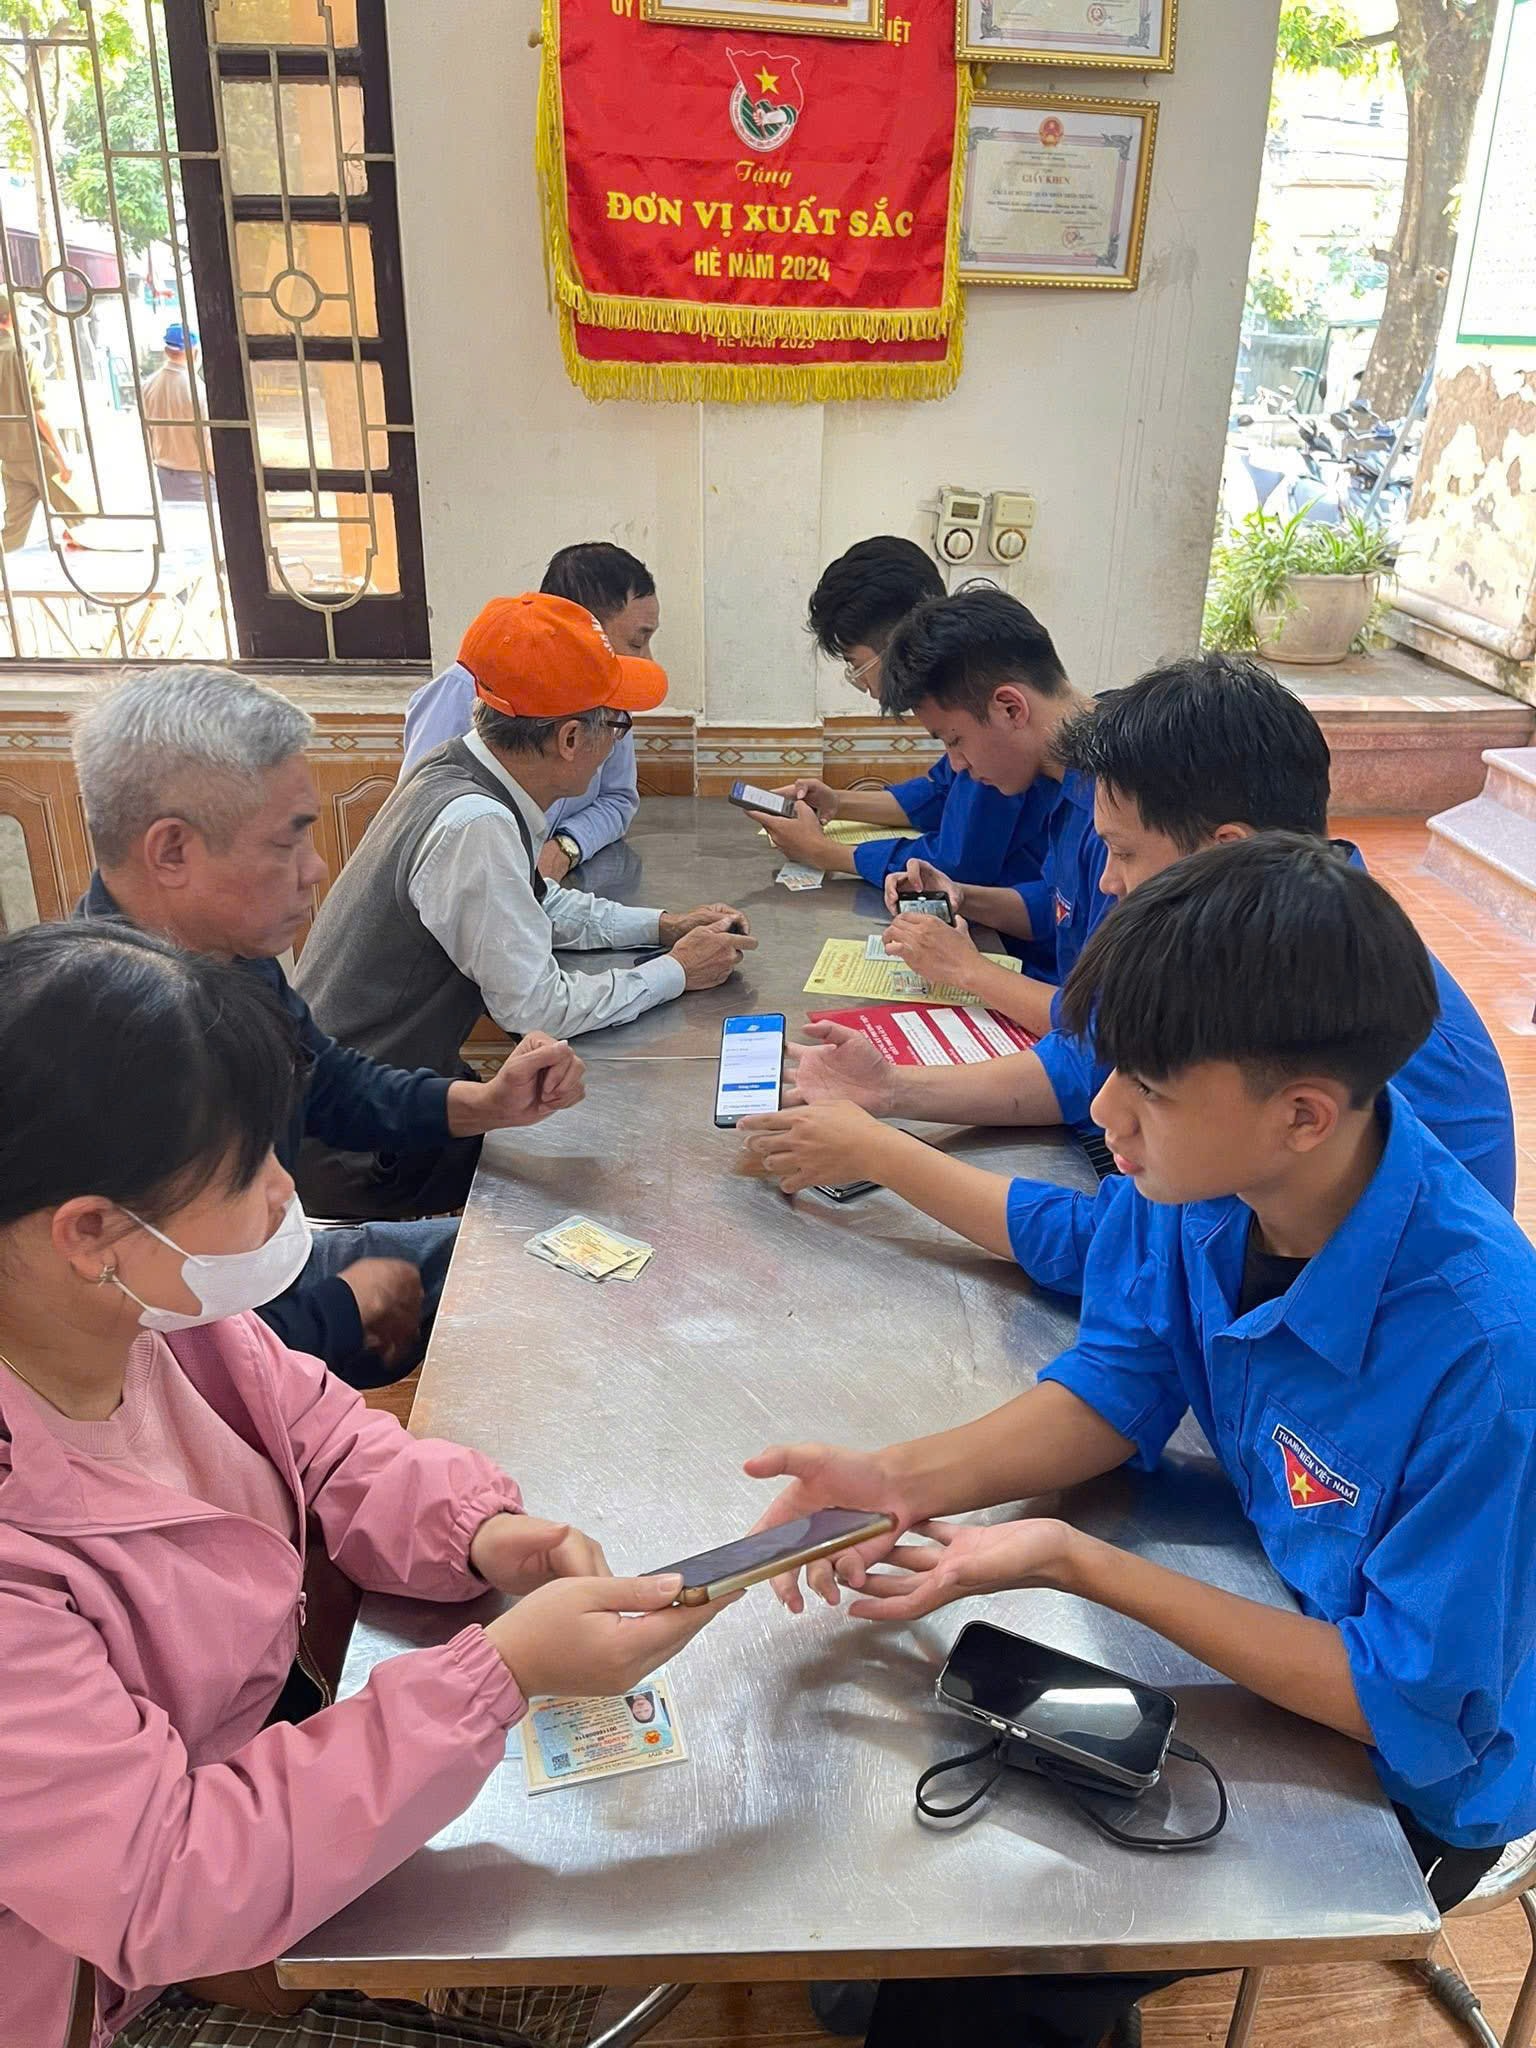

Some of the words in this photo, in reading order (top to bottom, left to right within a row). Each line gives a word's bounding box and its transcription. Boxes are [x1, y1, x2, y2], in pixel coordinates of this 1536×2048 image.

[887, 15, 912, 47] IỆT
[735, 160, 793, 189] Tặng
[606, 191, 683, 227] ĐƠN
[692, 201, 734, 238] VỊ
[742, 195, 841, 236] XUẤT
[848, 196, 914, 238] SẮC
[695, 246, 722, 277] HÈ
[728, 247, 775, 280] NĂM
[781, 254, 831, 282] 2024
[1332, 1480, 1355, 1500] NAM
